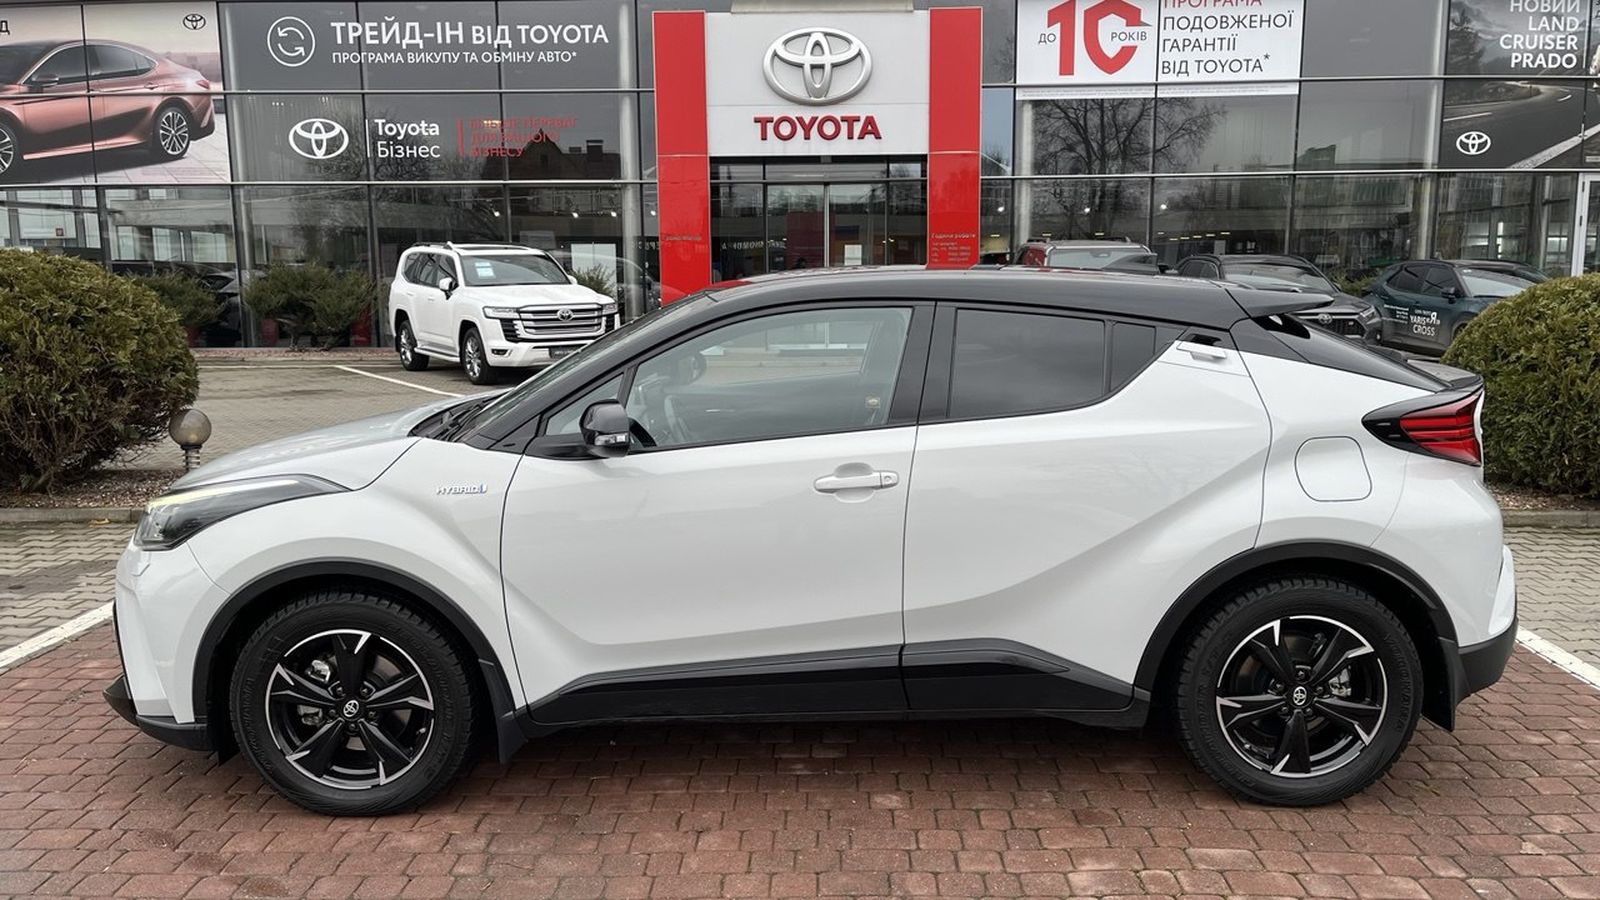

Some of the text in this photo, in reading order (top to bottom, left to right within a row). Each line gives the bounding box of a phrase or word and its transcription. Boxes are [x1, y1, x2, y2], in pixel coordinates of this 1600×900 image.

[1163, 10, 1294, 33] ПОДОВЖЕНОЇ
[1528, 15, 1579, 31] LAND
[331, 16, 609, 49] ТРЕЙД-ІН ВІД TOYOTA
[1038, 33, 1057, 44] ДО
[1111, 31, 1148, 42] РОКІВ
[1162, 34, 1238, 52] ГАРАНТІЇ
[1500, 34, 1578, 50] CRUISER
[332, 52, 404, 63] ПРОГРАМА
[408, 52, 460, 63] ВИКУПУ
[463, 52, 479, 63] ТА
[481, 52, 534, 63] ОБМІНУ
[1510, 52, 1577, 69] PRADO
[1161, 60, 1189, 76] ВІД
[374, 119, 440, 140] Toyota
[753, 115, 882, 141] TOYOTA
[377, 141, 440, 158] Бізнес
[1413, 324, 1435, 337] CROSS
